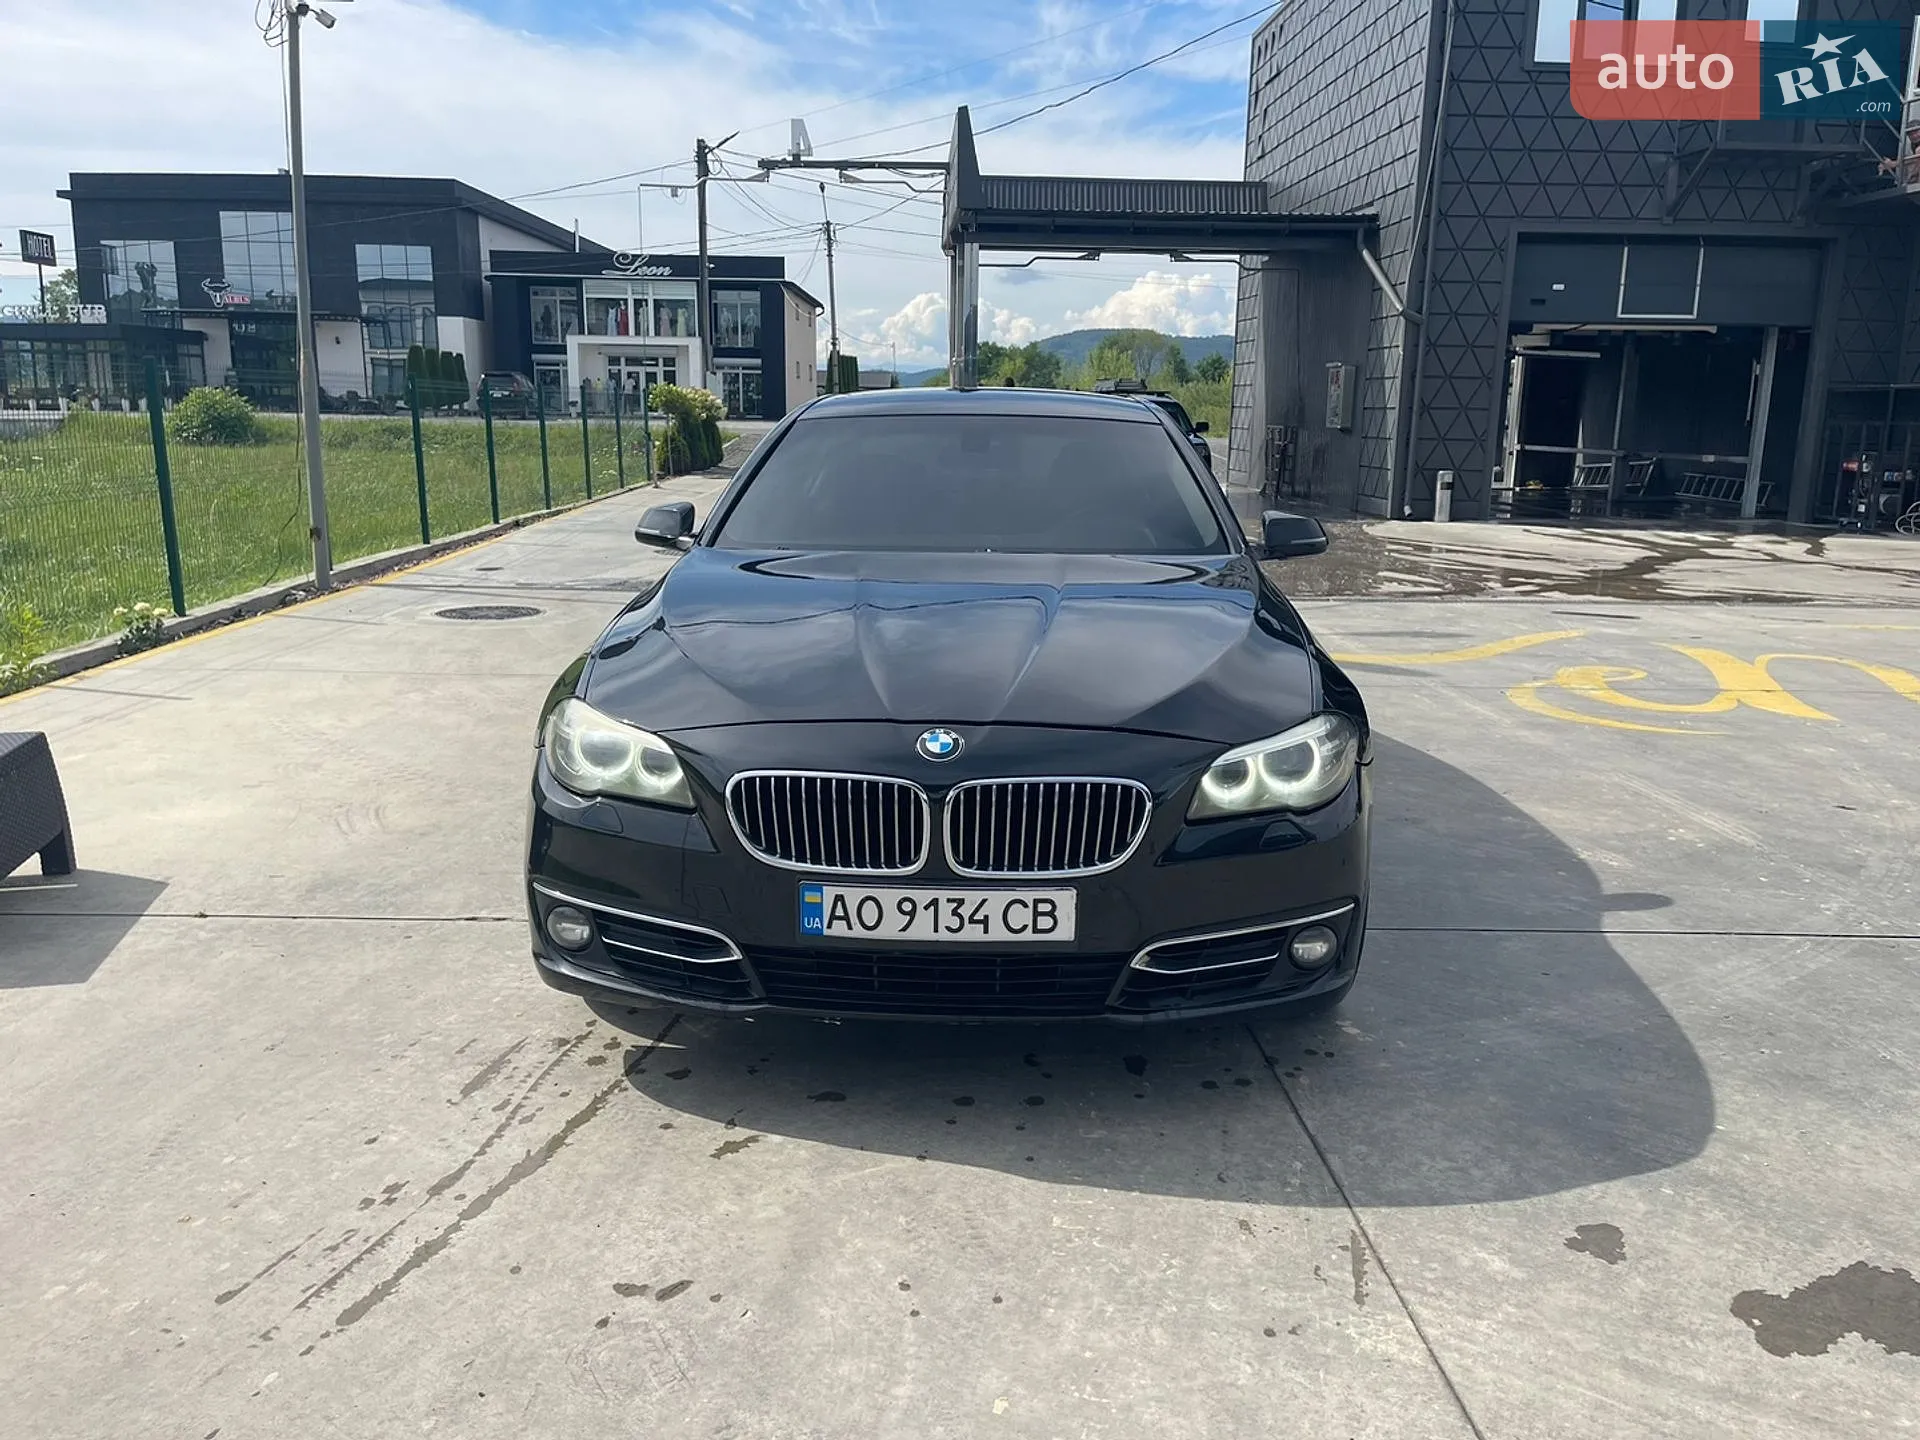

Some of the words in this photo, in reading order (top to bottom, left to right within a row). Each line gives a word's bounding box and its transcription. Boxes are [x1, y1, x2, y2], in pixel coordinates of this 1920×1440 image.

[26, 233, 54, 260] HOTEL
[601, 252, 673, 276] Leon
[803, 917, 823, 930] UA
[826, 893, 884, 932] AO
[896, 896, 990, 935] 9134
[1002, 898, 1059, 935] CB
